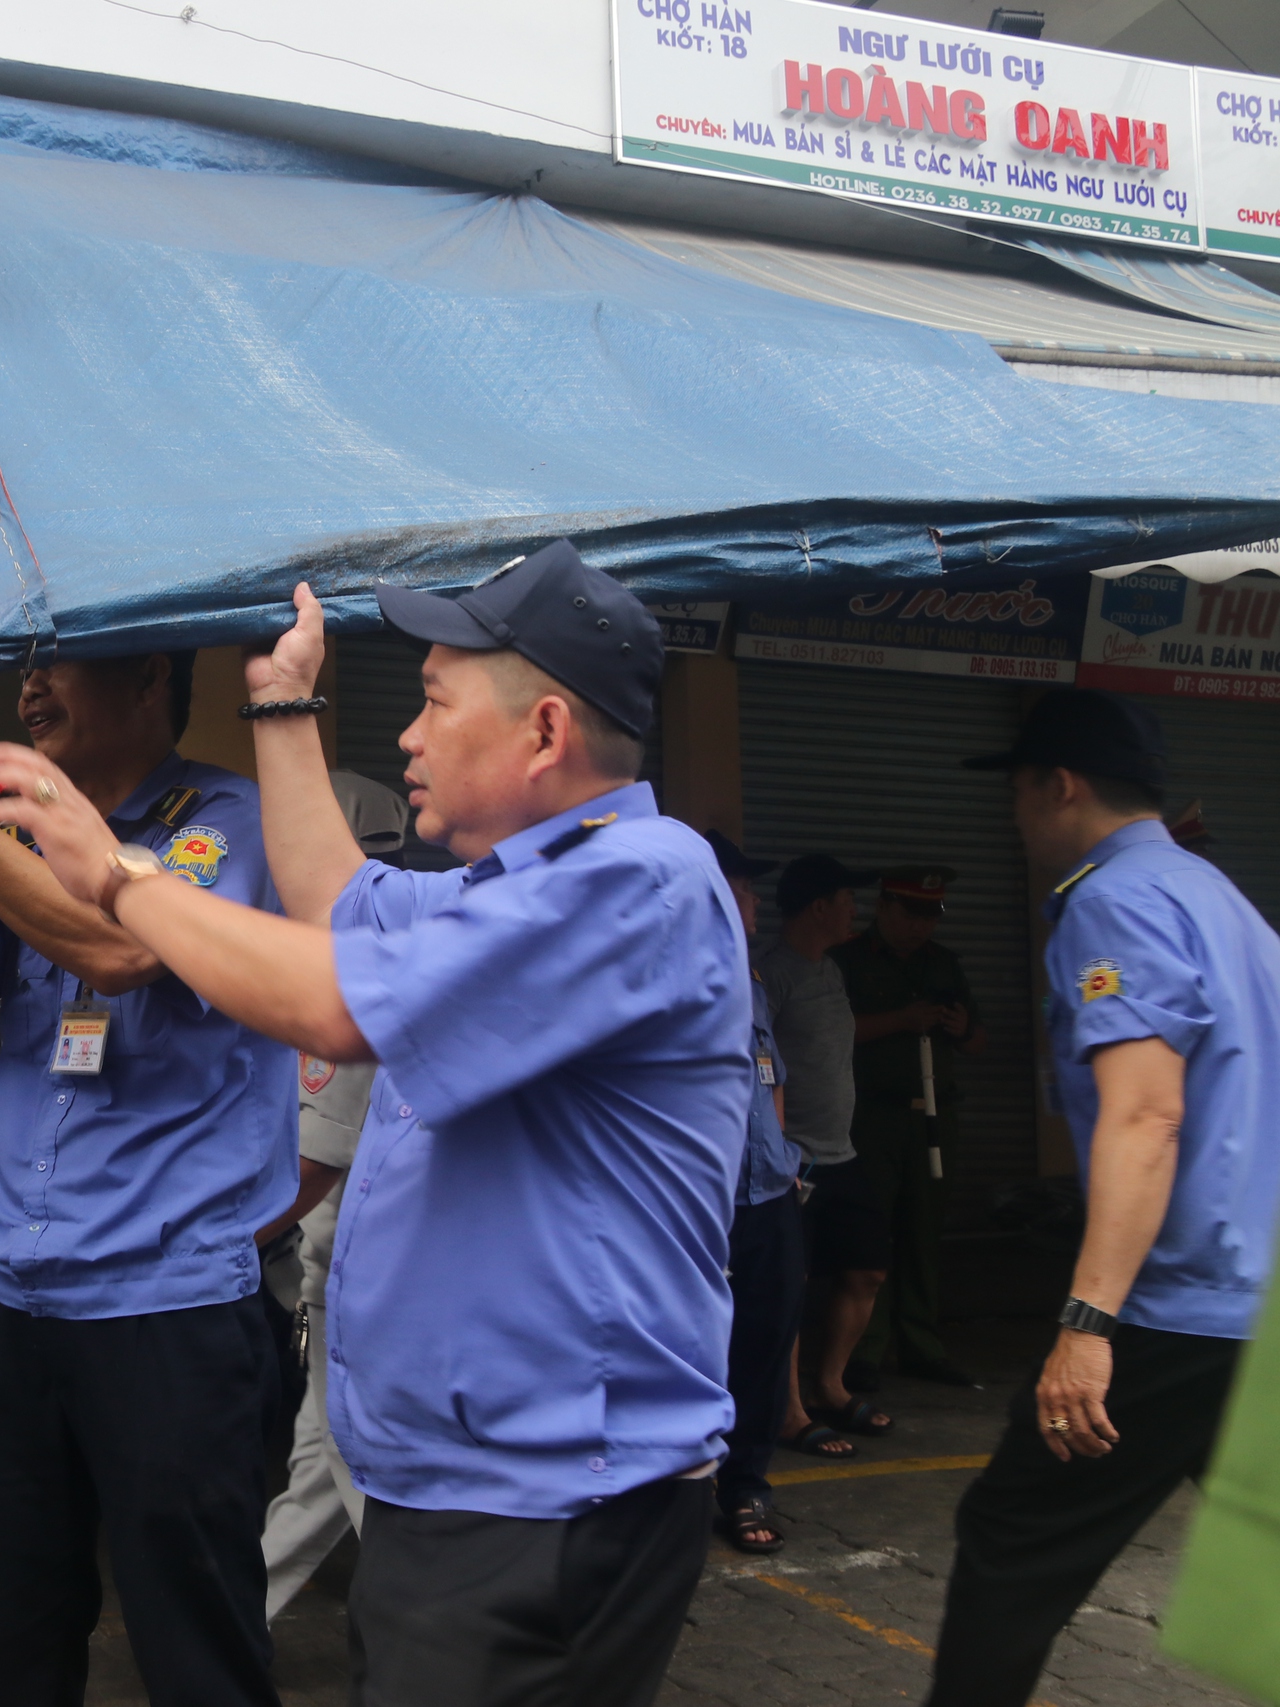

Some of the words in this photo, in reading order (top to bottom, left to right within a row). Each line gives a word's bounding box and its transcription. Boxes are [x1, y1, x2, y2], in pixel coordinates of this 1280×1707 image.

[637, 0, 690, 29] CHỢ
[656, 25, 712, 54] KIỐT:
[720, 34, 748, 59] 18
[838, 26, 909, 62] NGƯ
[919, 39, 992, 77] LƯỚI
[1002, 54, 1045, 91] CỤ
[783, 58, 988, 141] HOÀNG
[1014, 100, 1170, 171] OANH
[1217, 91, 1262, 124] CHỢ
[655, 113, 727, 140] CHUYÊN:
[732, 118, 776, 148] MUA
[784, 122, 825, 155] BÁN
[835, 130, 852, 160] SỈ
[860, 140, 875, 164] &
[884, 138, 907, 169] LẺ
[914, 144, 952, 176] CÁC
[959, 153, 997, 187] MẶT
[1006, 160, 1058, 193] HÀNG
[1065, 173, 1105, 200] NGƯ
[1114, 179, 1155, 208] LƯỚI
[1163, 188, 1188, 219] CỤ
[810, 171, 886, 197] HOTLINE:
[752, 640, 787, 658] TEL:
[1159, 642, 1205, 666] MUA
[1210, 643, 1253, 670] BÁN
[990, 657, 1058, 679] 0905.133.155
[1198, 677, 1230, 695] 0905
[1233, 680, 1257, 697] 912
